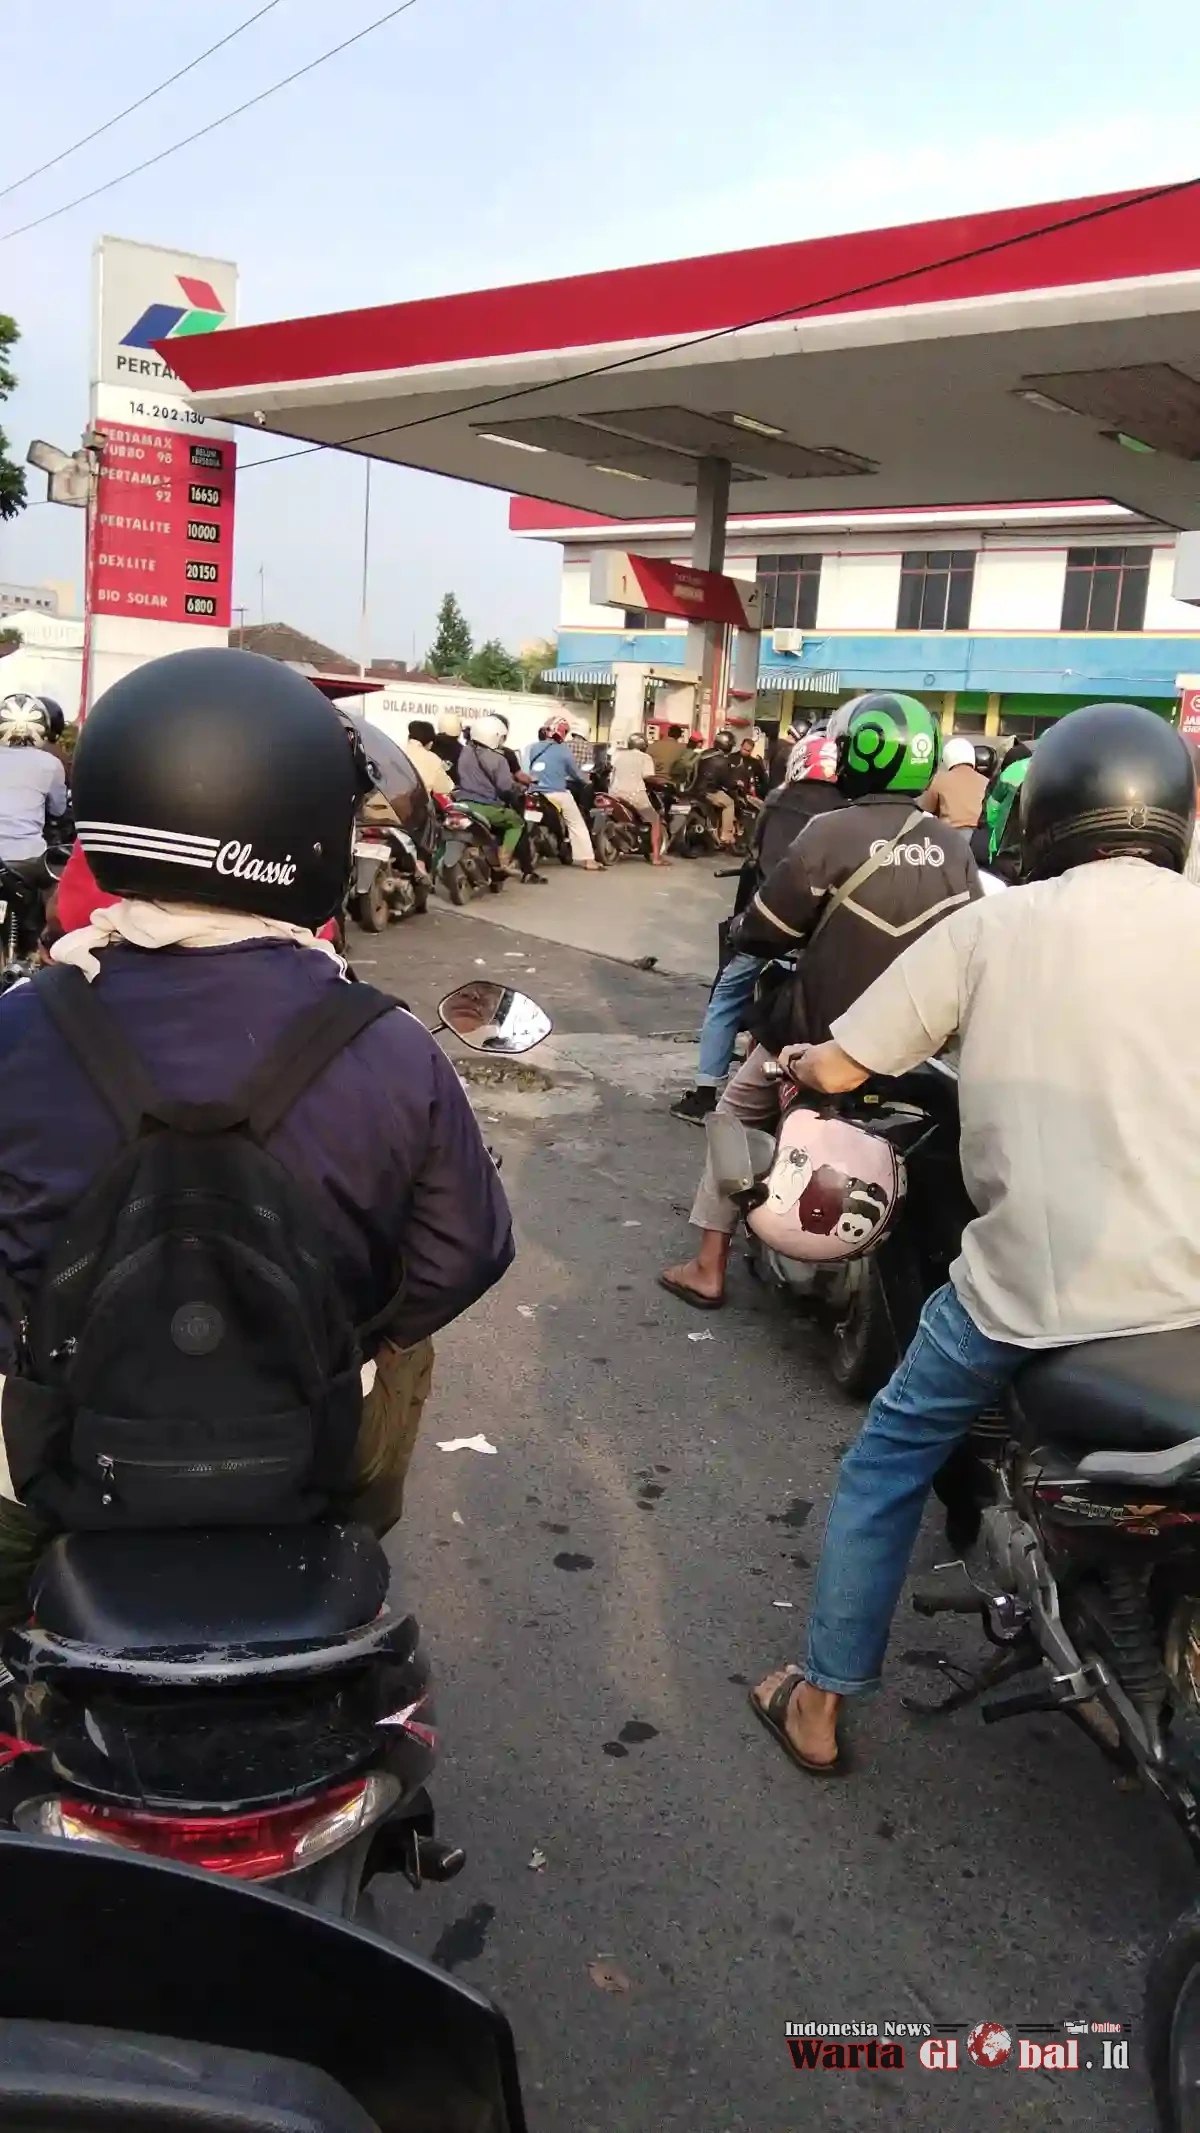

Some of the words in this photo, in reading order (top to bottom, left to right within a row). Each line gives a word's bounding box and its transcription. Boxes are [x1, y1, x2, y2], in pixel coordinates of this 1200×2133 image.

[116, 355, 178, 380] PERTA
[130, 401, 205, 425] 14.202.130
[156, 452, 172, 464] 98
[101, 466, 172, 488] PERTAMAX
[156, 490, 172, 503] 92
[190, 487, 219, 504] 16650
[101, 513, 171, 534] PERTALITE
[187, 523, 217, 541] 10000
[98, 553, 156, 572] DEXLITE
[186, 564, 216, 580] 20150
[98, 588, 120, 602] BIO
[126, 592, 168, 607] SOLAR
[187, 598, 213, 614] 6800
[869, 836, 945, 867] Grab
[215, 840, 297, 886] Classic
